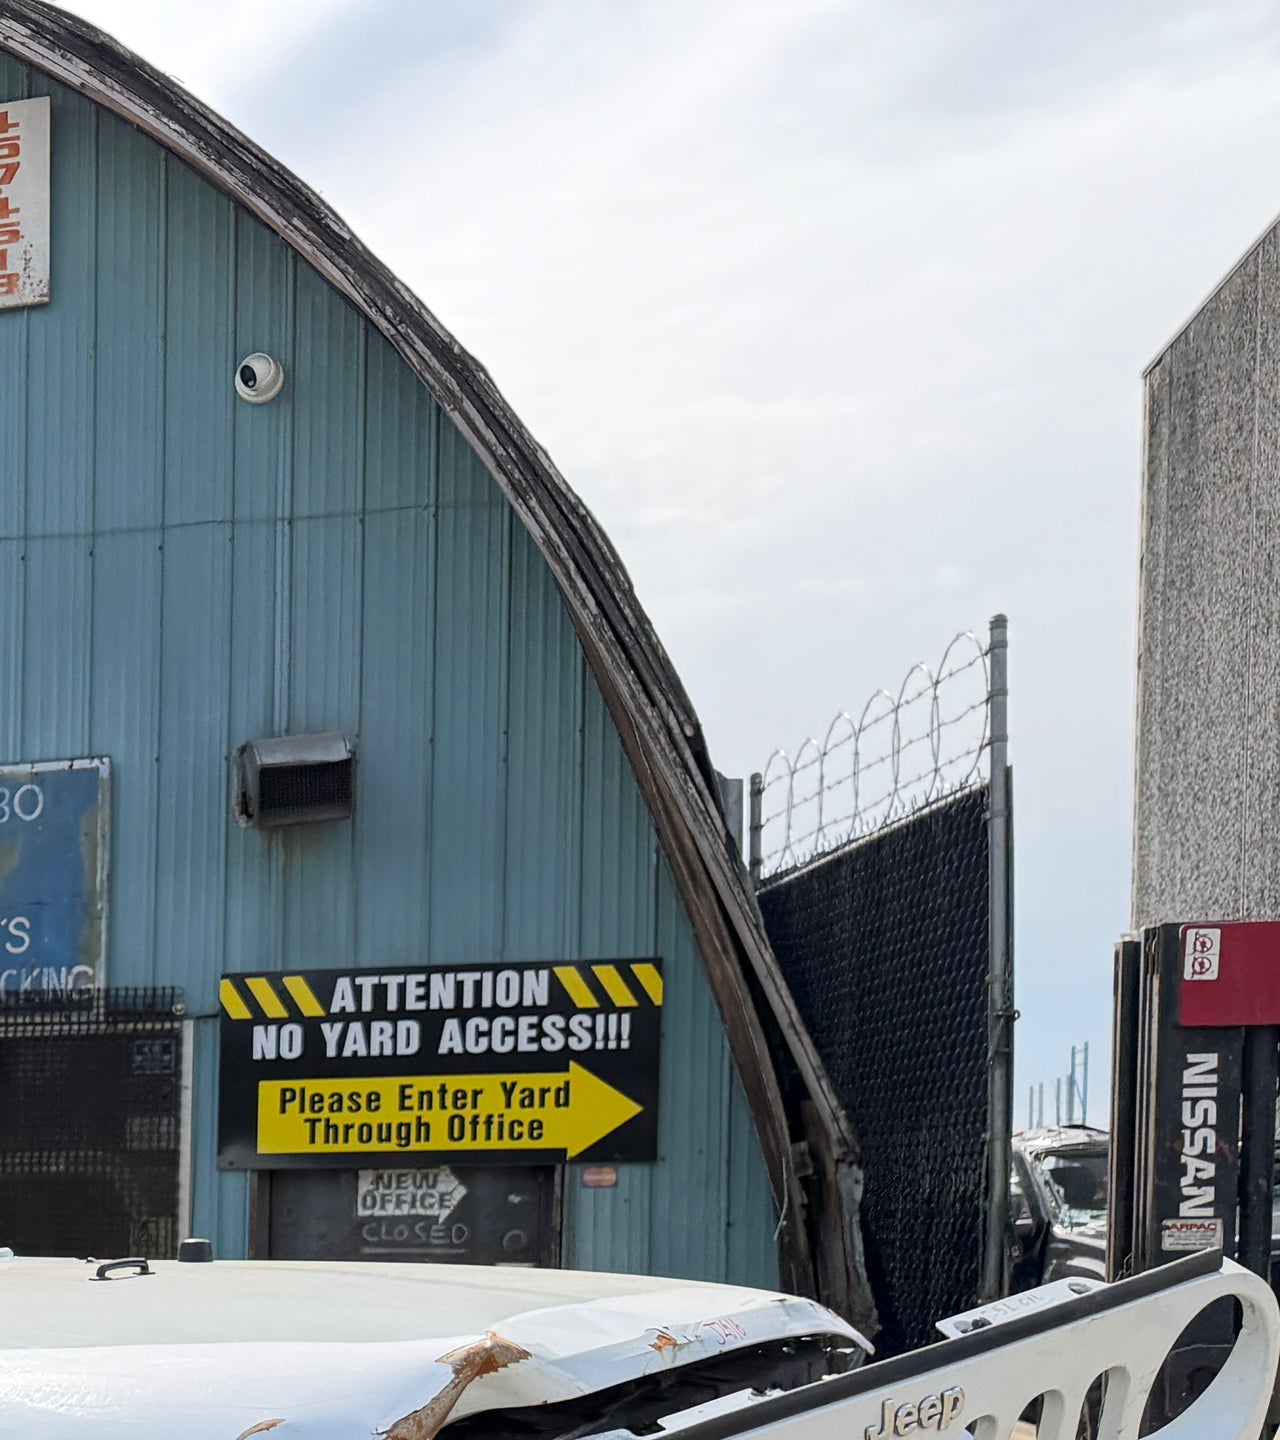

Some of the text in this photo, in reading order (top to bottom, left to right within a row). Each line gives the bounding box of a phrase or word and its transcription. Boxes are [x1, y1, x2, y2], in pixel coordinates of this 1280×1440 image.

[329, 970, 549, 1014] ATTENTION
[252, 1013, 632, 1060] NO YARD ACCESS!!!
[279, 1080, 571, 1115] Please Enter Yard
[304, 1114, 545, 1149] Through Office
[1178, 1052, 1219, 1218] NISSAN
[370, 1170, 438, 1191] NEW
[362, 1191, 454, 1211] OFFICE
[362, 1222, 468, 1246] CLOSED
